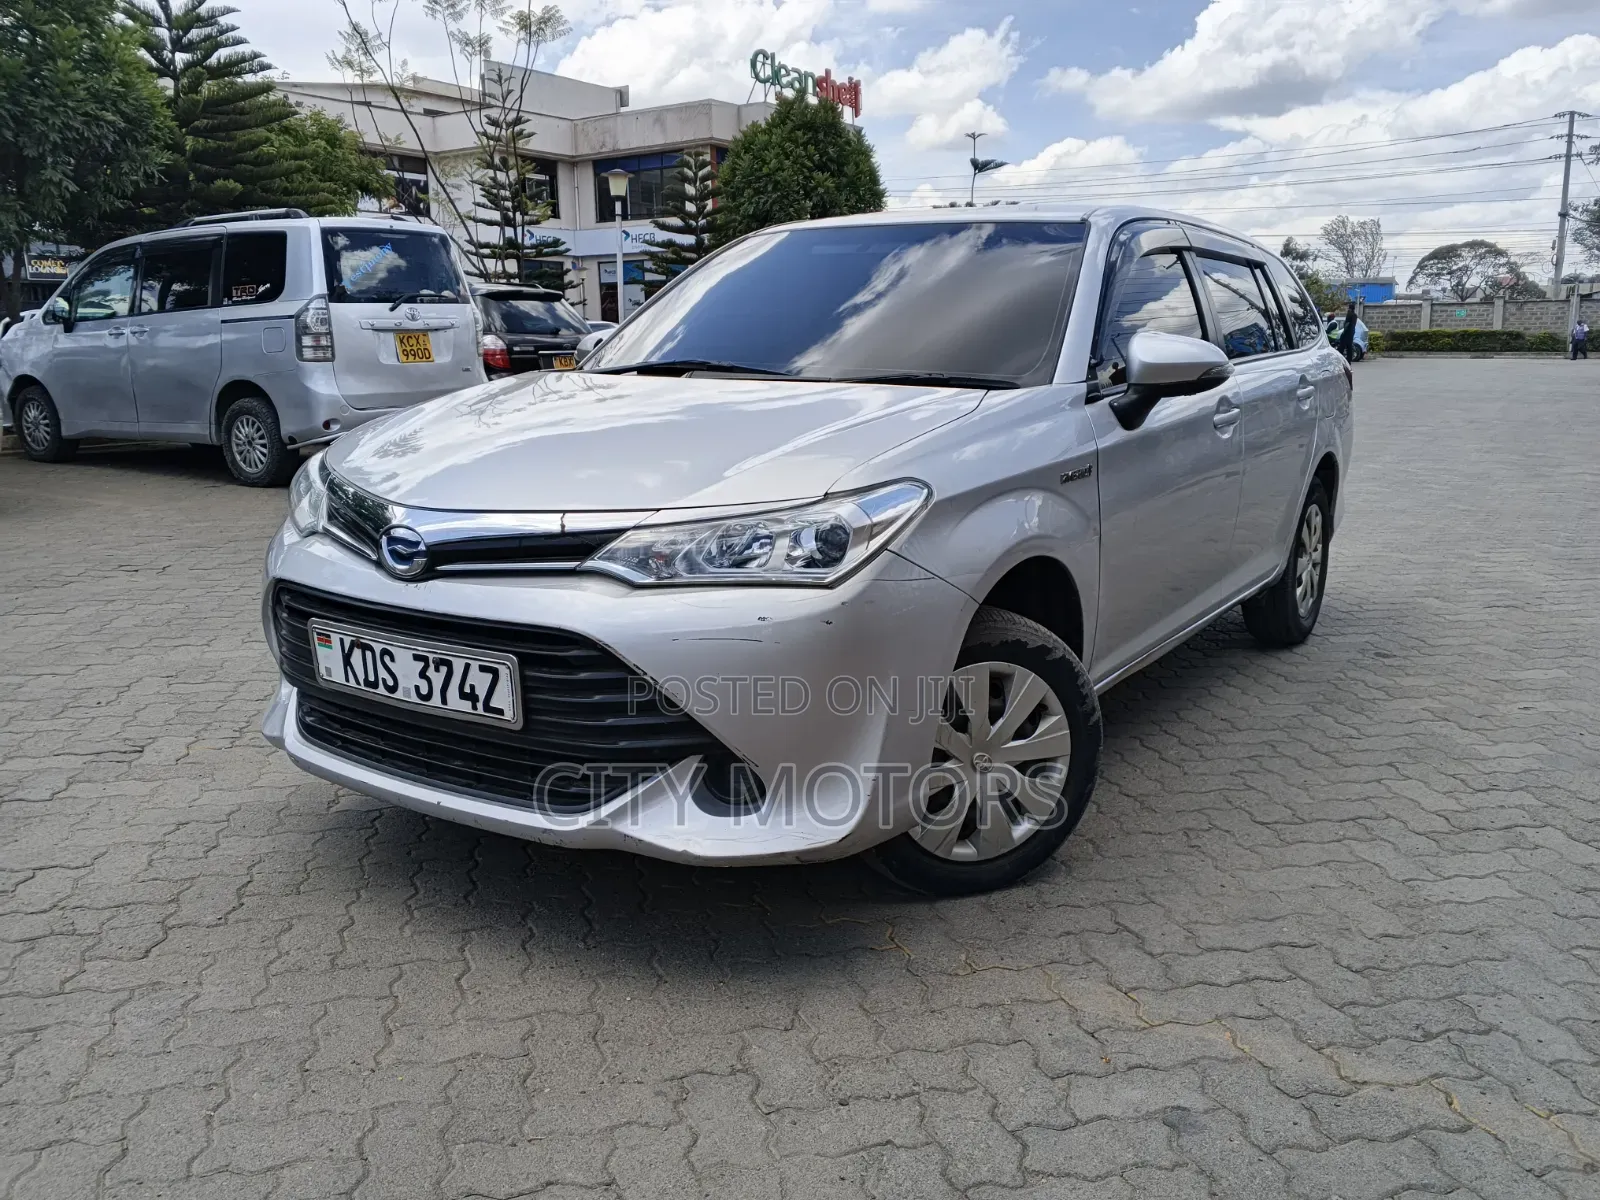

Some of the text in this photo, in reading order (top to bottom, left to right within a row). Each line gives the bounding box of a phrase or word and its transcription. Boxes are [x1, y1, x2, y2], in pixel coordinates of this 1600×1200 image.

[398, 335, 421, 348] KCX
[559, 355, 574, 368] KBX
[339, 637, 399, 695] KDS
